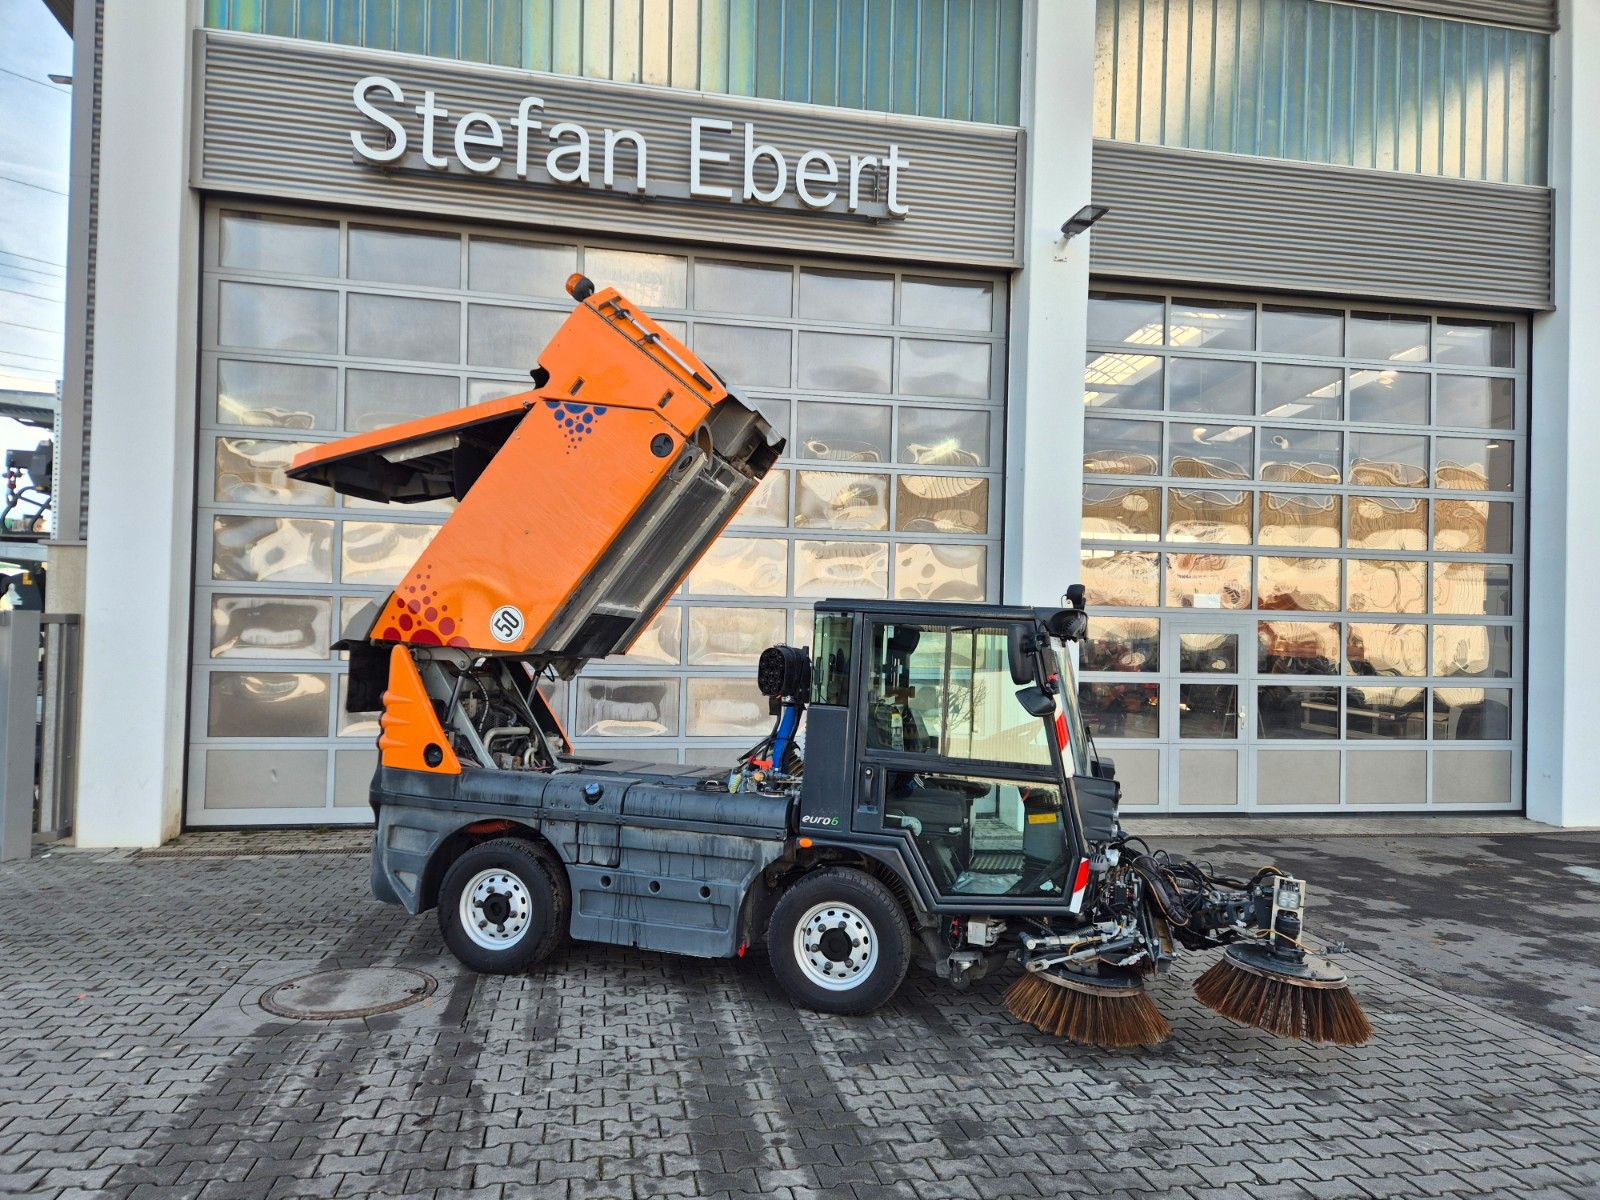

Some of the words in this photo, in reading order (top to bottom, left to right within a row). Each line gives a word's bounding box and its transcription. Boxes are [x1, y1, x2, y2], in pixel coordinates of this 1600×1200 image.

[350, 76, 648, 193] Stefan
[689, 117, 910, 216] Ebert
[494, 610, 520, 638] 50
[801, 815, 839, 826] euro6
